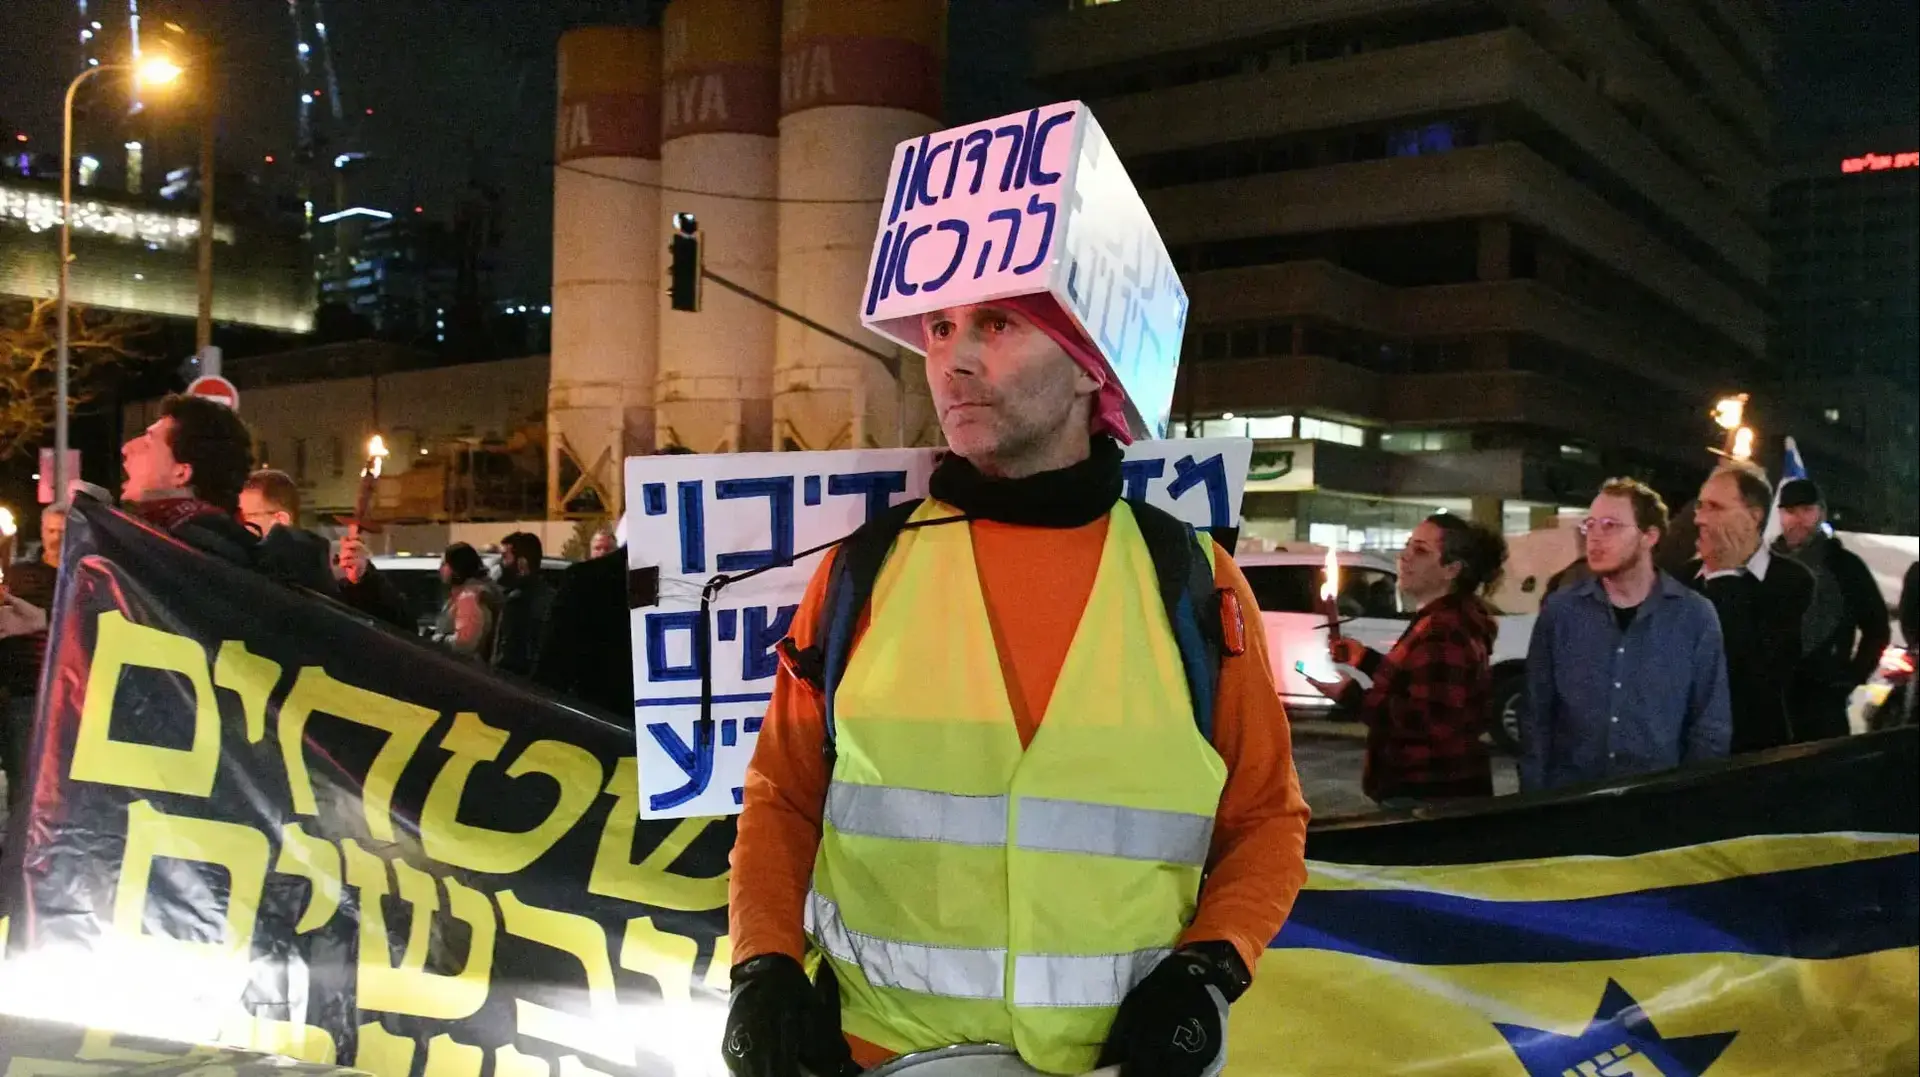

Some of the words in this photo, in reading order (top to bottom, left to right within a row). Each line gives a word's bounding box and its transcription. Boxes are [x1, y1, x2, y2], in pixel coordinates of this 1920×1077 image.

[887, 107, 1076, 226] ארדואן
[865, 218, 970, 316] כאן
[972, 193, 1057, 280] לה
[642, 470, 907, 574] דיכוי
[645, 603, 801, 682] שים
[646, 716, 764, 811] יע
